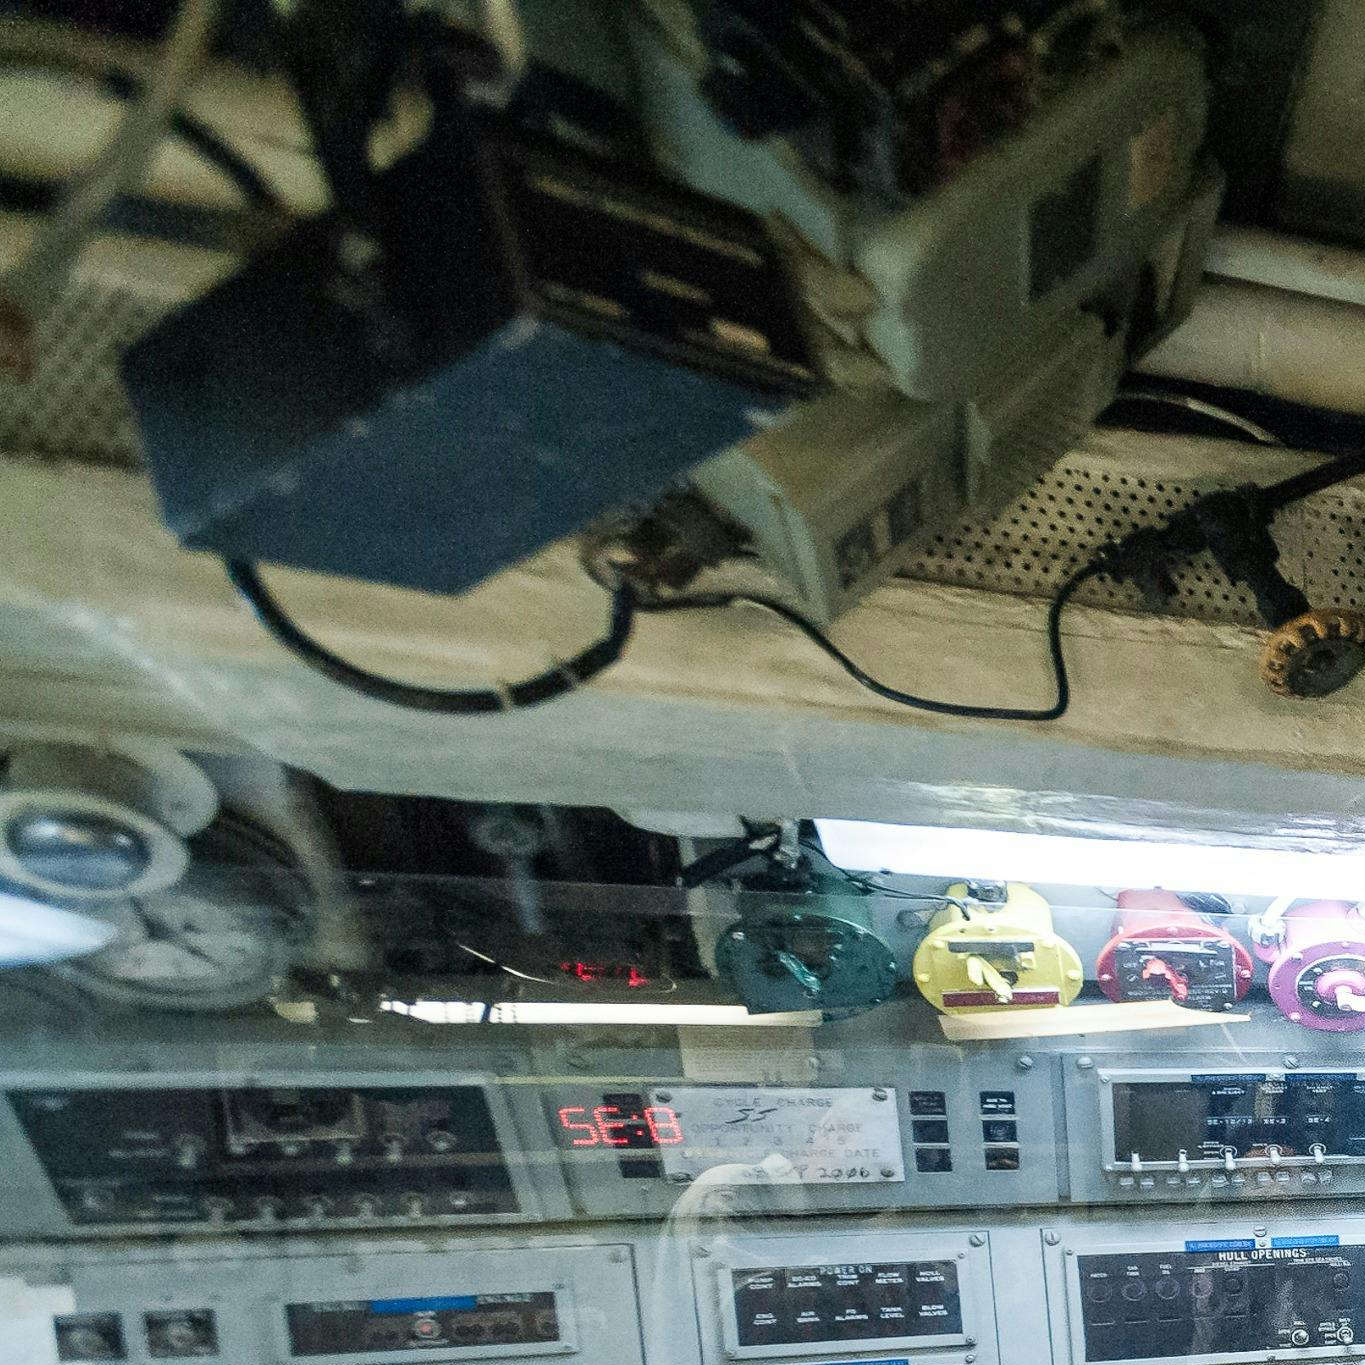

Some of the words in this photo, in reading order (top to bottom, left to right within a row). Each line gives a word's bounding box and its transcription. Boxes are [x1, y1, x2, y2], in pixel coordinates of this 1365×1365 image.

[777, 1097, 832, 1108] CHARGE
[845, 1148, 881, 1158] DATE
[1218, 1251, 1248, 1261] HULL
[1251, 1249, 1307, 1260] OPENINGS
[859, 1264, 873, 1273] ON
